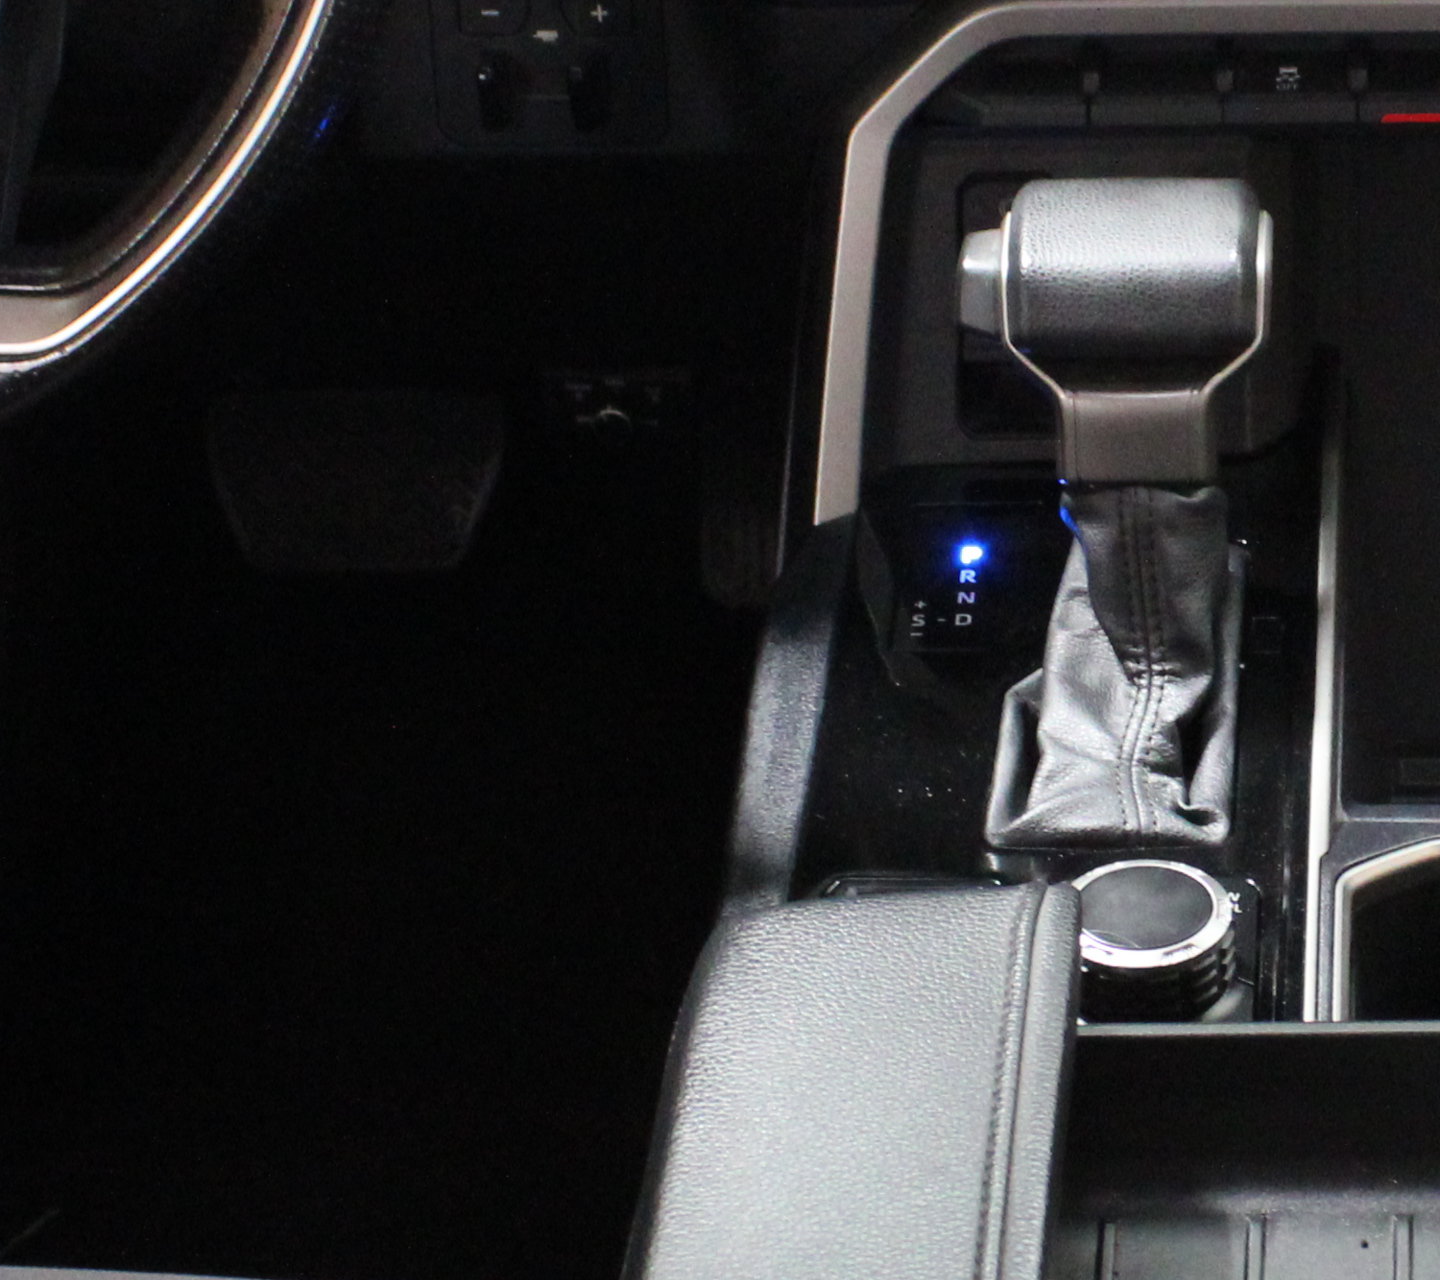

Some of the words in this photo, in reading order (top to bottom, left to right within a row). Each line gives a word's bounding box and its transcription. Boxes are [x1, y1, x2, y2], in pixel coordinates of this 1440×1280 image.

[959, 545, 984, 567] P
[958, 568, 977, 584] R
[956, 590, 976, 605] N
[910, 613, 927, 627] S
[954, 612, 973, 627] D
